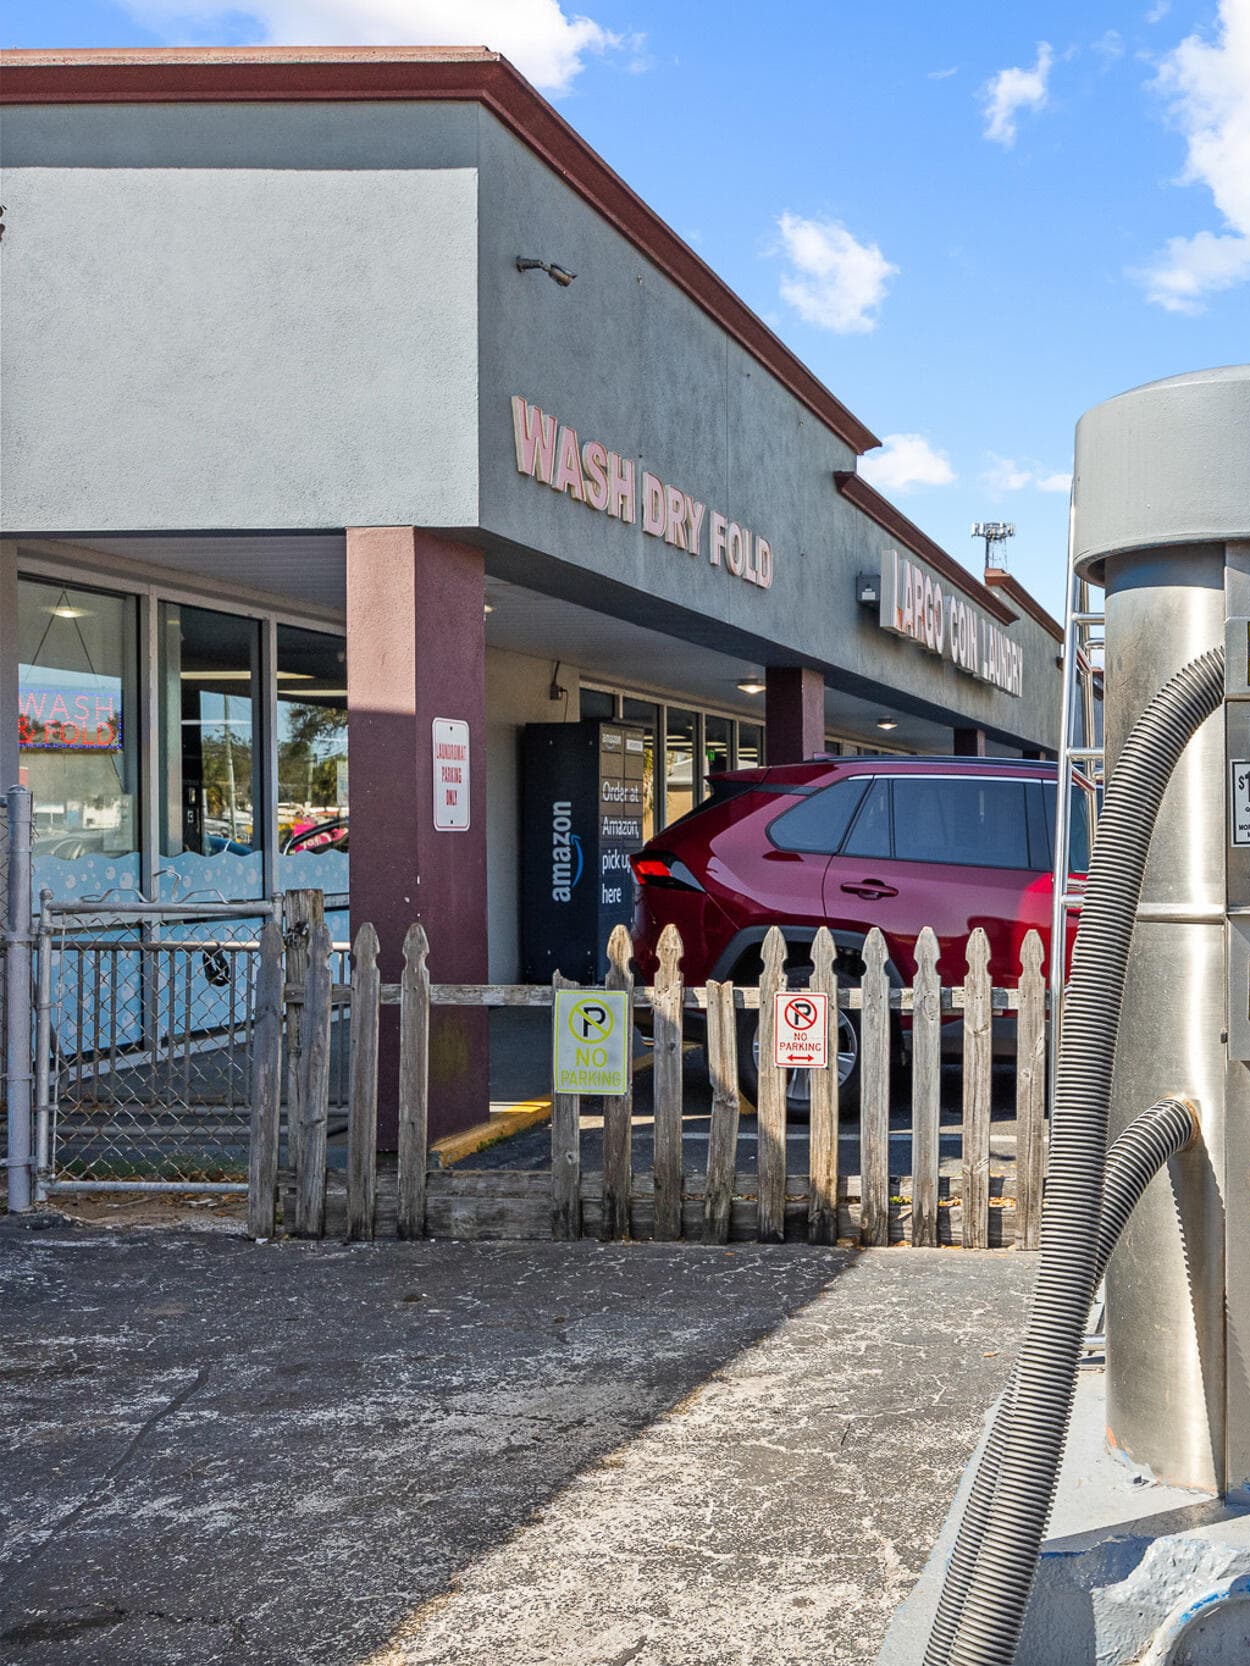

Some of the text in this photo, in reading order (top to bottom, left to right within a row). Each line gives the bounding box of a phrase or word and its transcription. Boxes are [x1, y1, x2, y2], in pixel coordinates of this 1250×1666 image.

[511, 395, 774, 590] WASH DRY FOLD
[880, 549, 1023, 698] LARGO COIN LAUNDRY
[18, 692, 114, 721] WASH
[17, 717, 115, 746] & FOLD
[441, 766, 462, 784] PARKING
[446, 789, 458, 806] ONLY
[602, 781, 639, 802] Order at
[602, 817, 639, 839] Amazon,
[552, 801, 572, 902] amazon
[602, 850, 621, 875] pick
[602, 884, 622, 904] here
[779, 1041, 822, 1052] PARKING
[793, 1032, 808, 1042] NO
[575, 1047, 608, 1069] NO
[561, 1069, 621, 1088] PARKING
